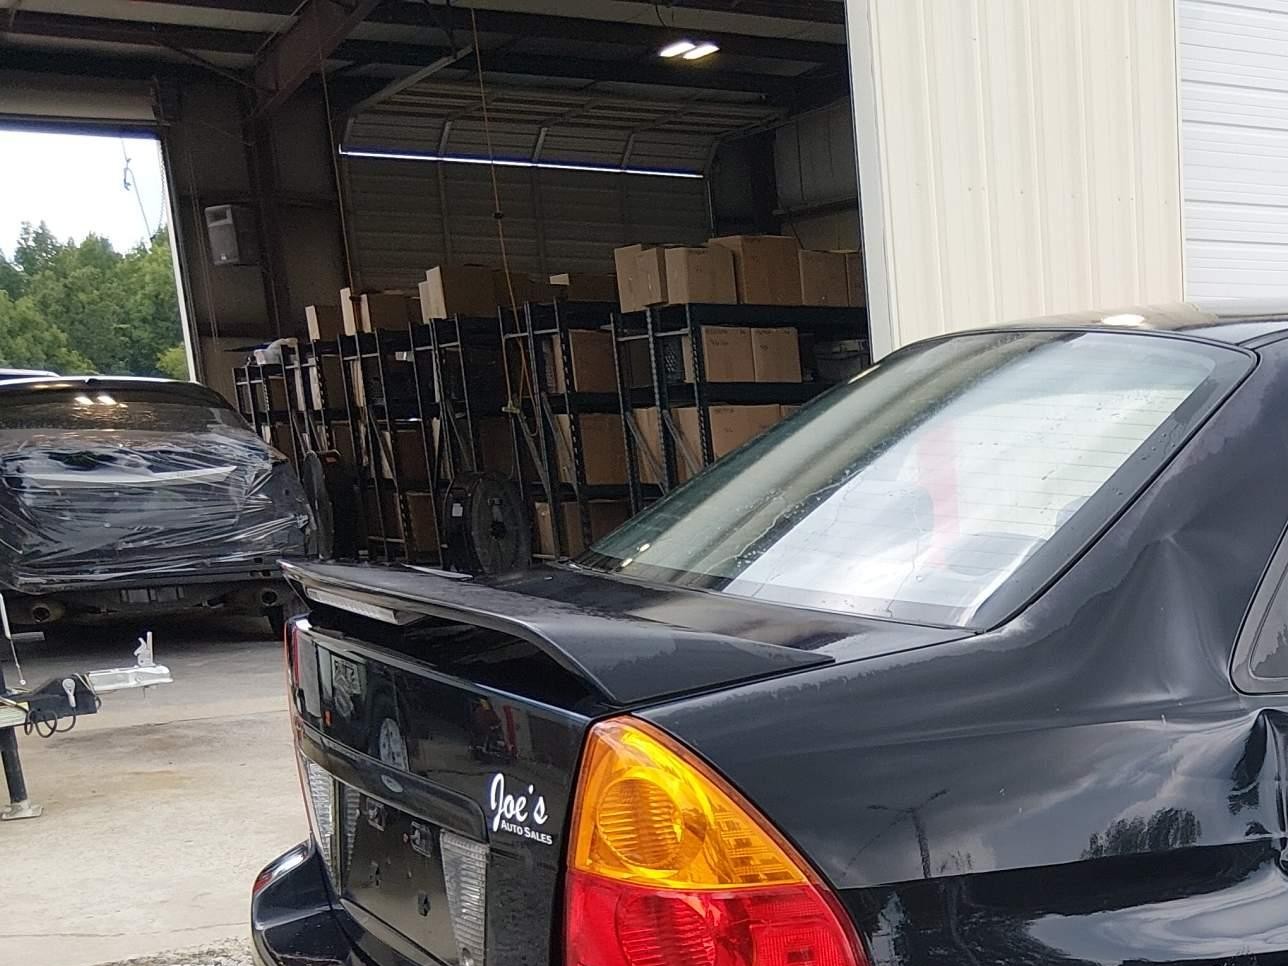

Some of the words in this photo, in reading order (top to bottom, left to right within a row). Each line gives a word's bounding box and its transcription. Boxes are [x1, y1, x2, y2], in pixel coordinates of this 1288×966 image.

[490, 772, 549, 832] Joe's
[501, 819, 524, 836] AUTO
[523, 826, 553, 845] SALES
